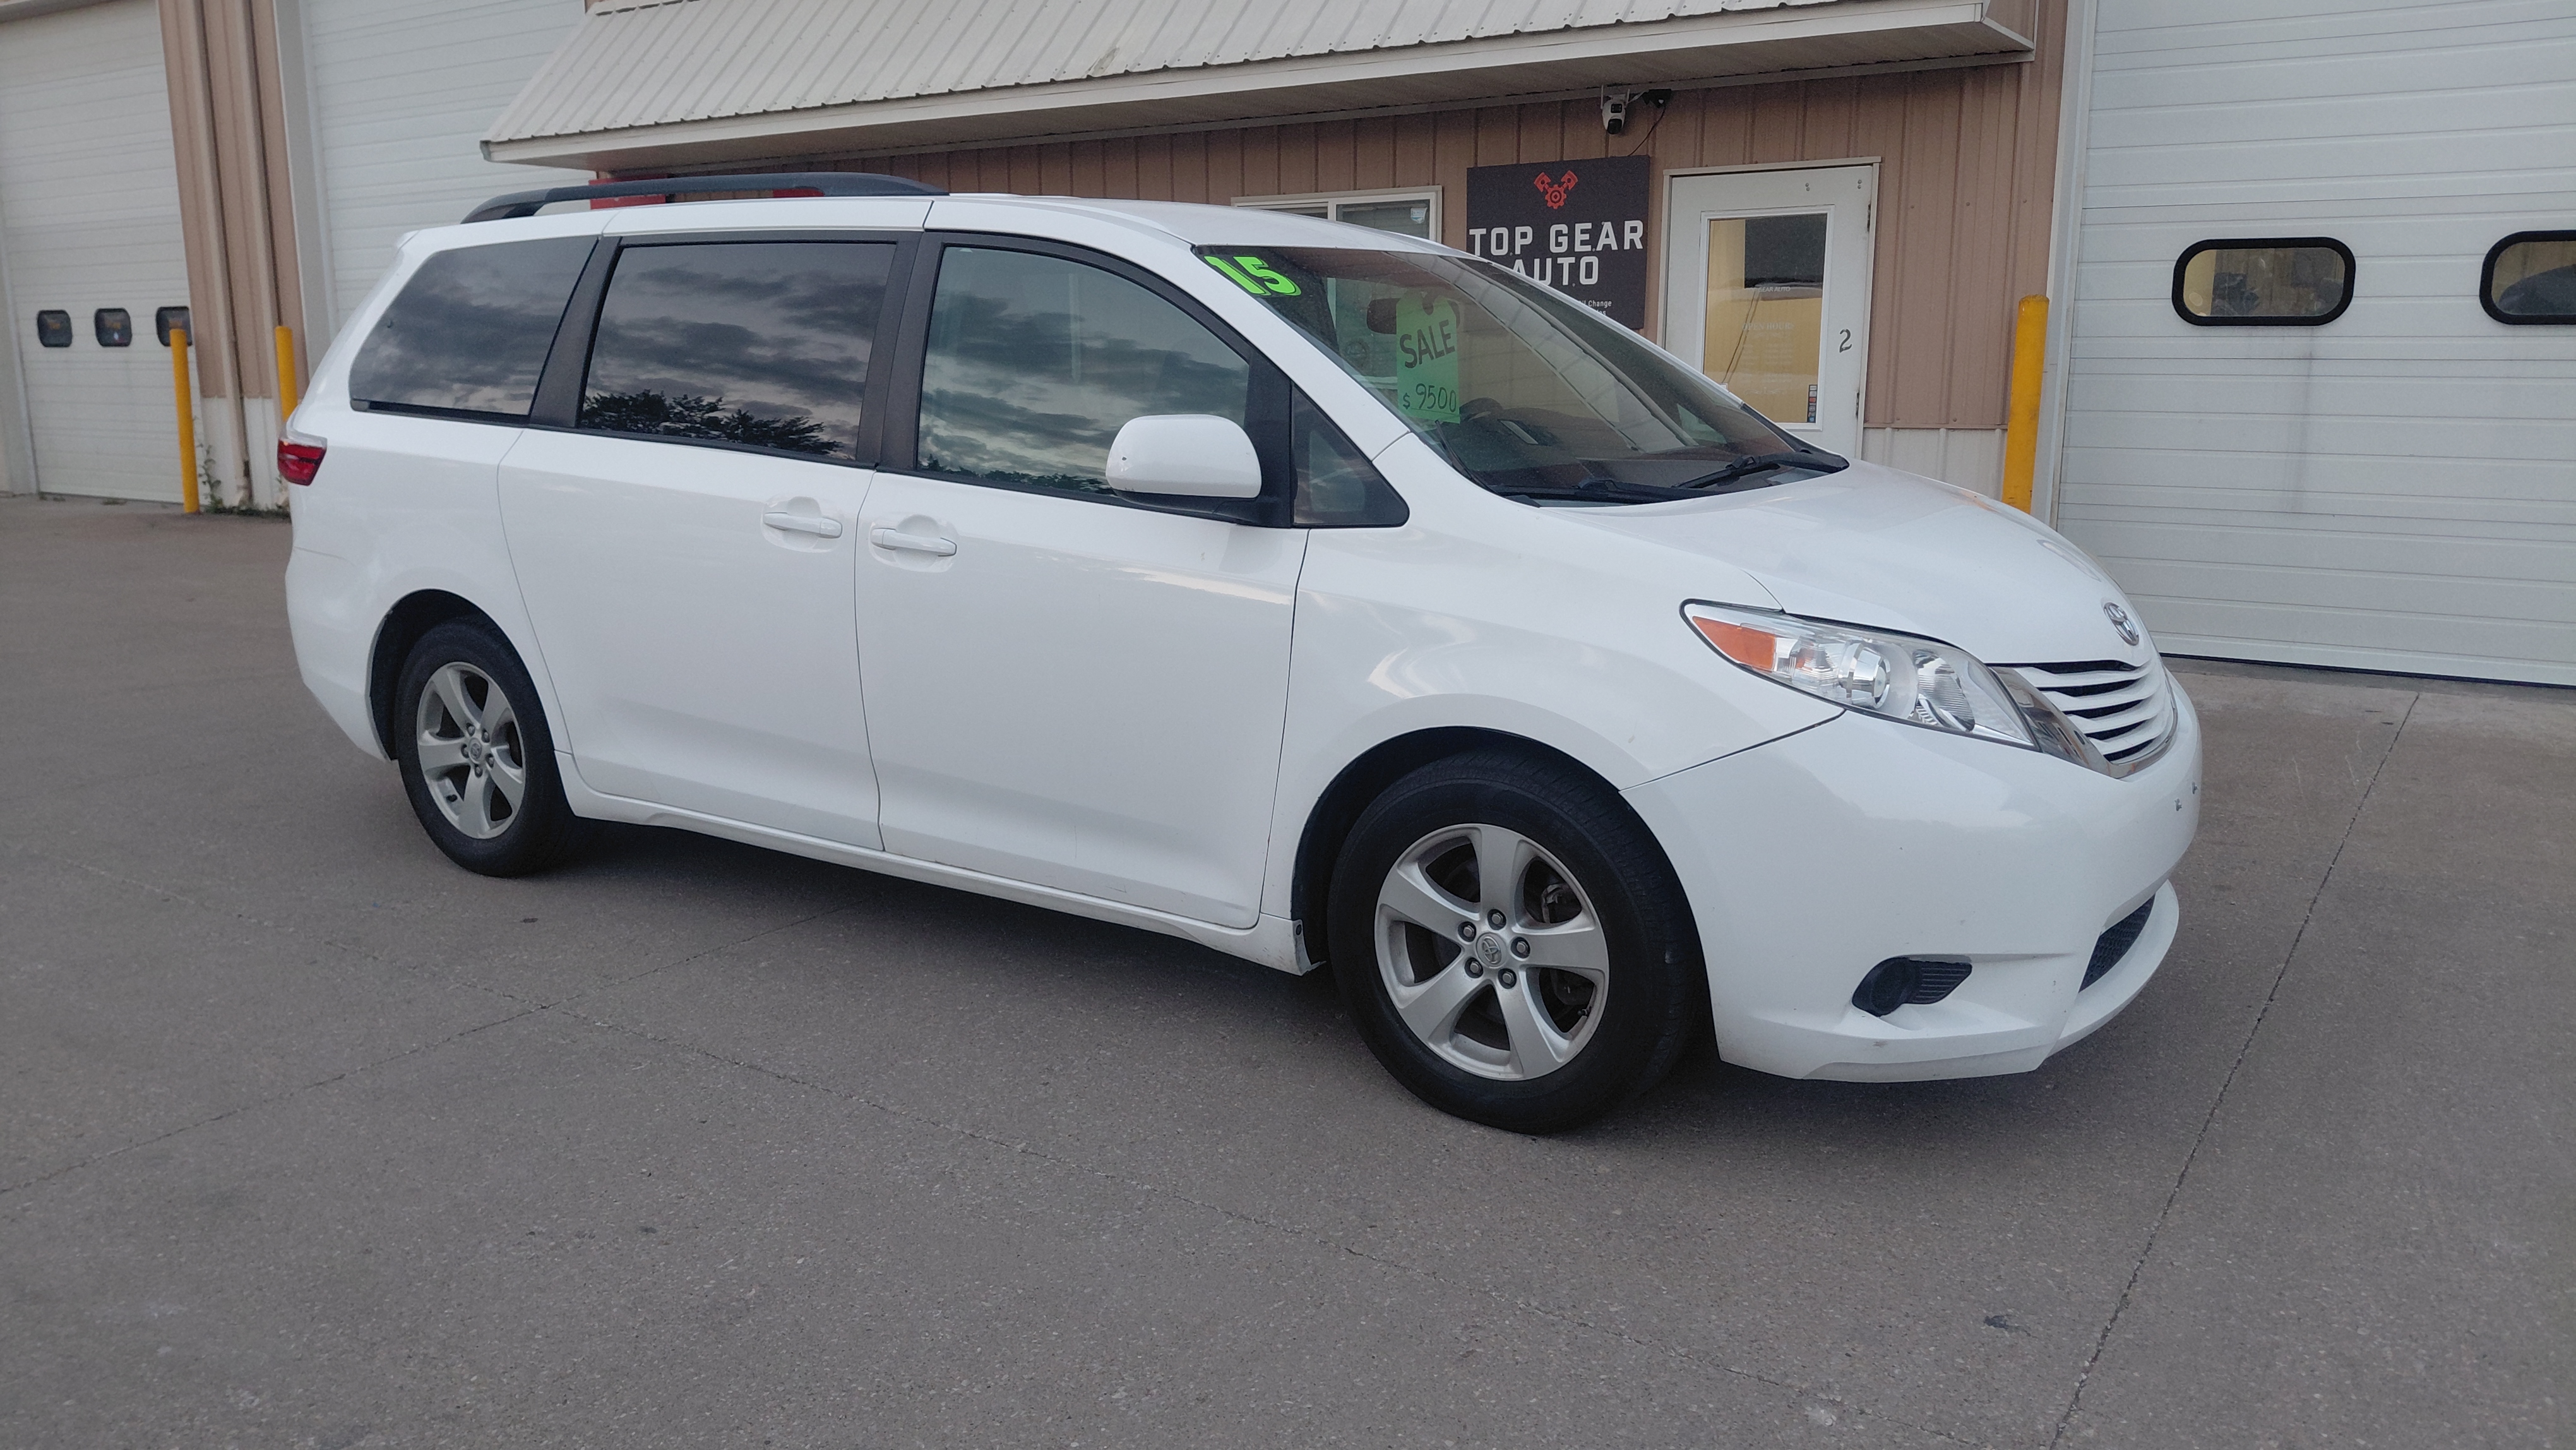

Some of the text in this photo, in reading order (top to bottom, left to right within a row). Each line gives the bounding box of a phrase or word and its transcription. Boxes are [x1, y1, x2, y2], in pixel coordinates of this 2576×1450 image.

[1469, 220, 1643, 256] TOP GEAR
[1203, 255, 1302, 296] 15
[1513, 255, 1599, 286] AUTO
[1588, 299, 1613, 309] Change
[1399, 319, 1455, 369] SALE
[1839, 328, 1852, 353] 2
